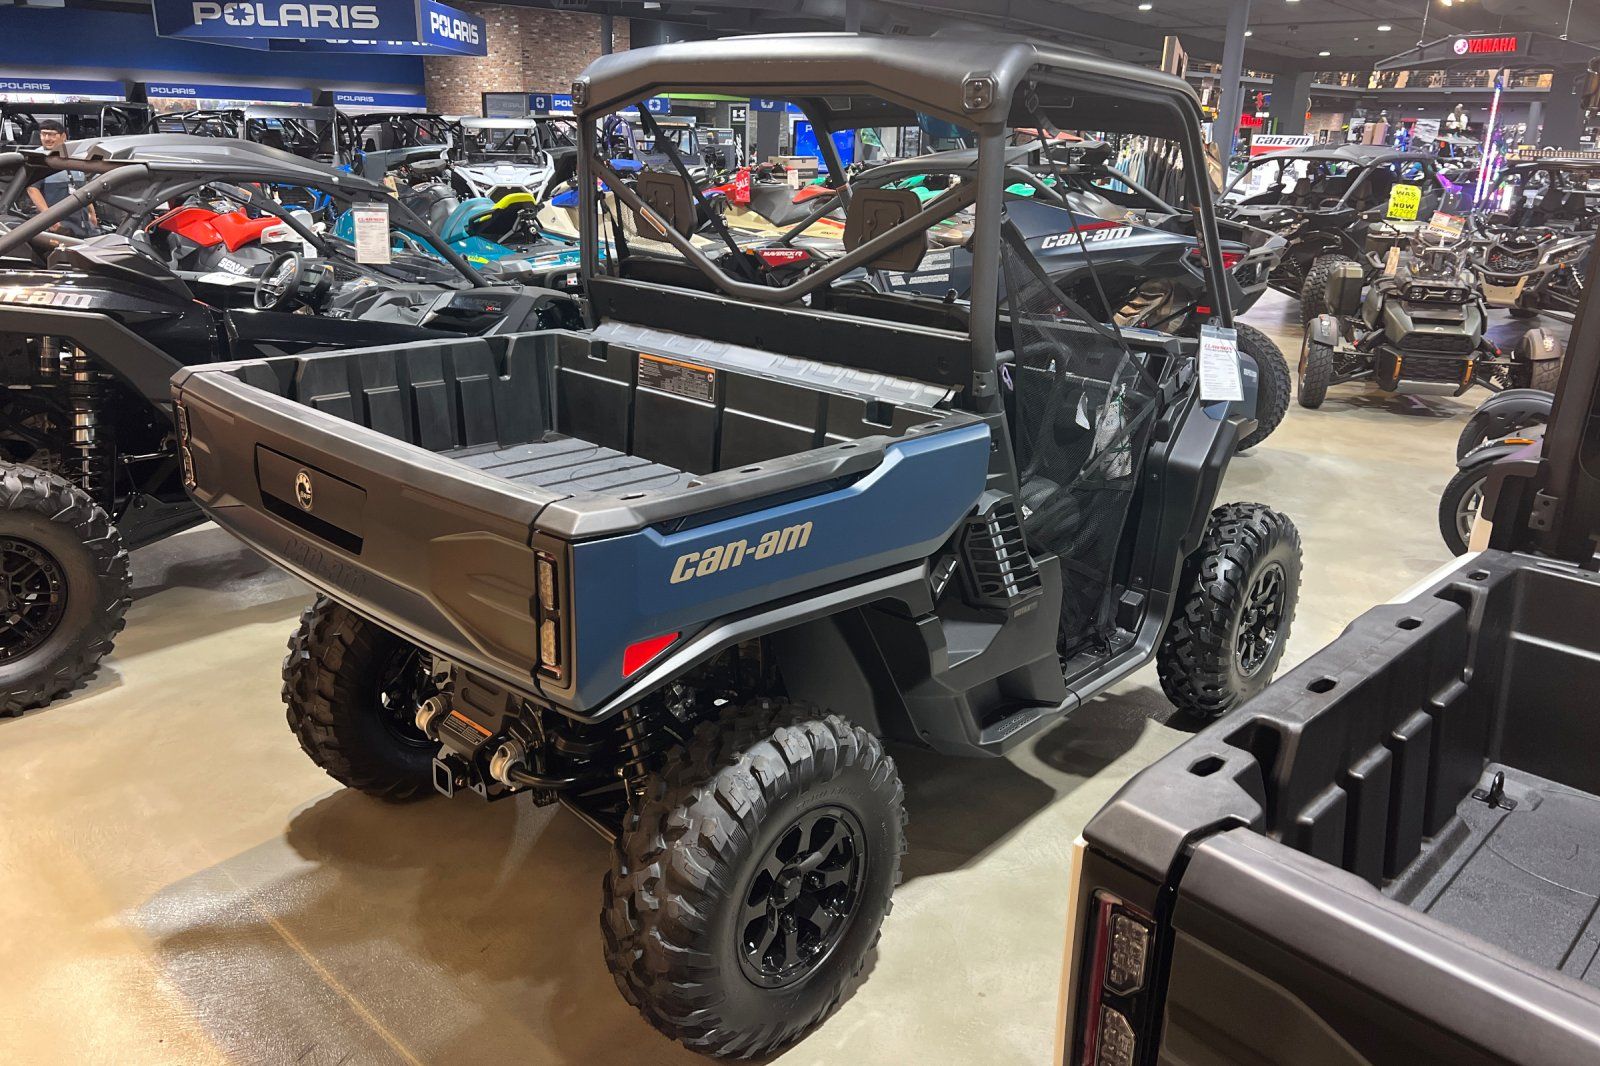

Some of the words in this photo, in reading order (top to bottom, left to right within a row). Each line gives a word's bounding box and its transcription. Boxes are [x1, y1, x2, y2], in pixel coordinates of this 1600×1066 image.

[191, 2, 380, 30] POLARIS
[429, 11, 479, 45] POLARIS
[1468, 37, 1517, 53] YAMAHA
[0, 82, 51, 90] POLARIS
[150, 86, 196, 95] POLARIS
[337, 95, 375, 103] POLARIS
[1255, 136, 1310, 145] can-am
[736, 177, 749, 191] SALE
[1396, 190, 1416, 198] WAS
[1041, 226, 1133, 249] can-am
[669, 521, 813, 584] can-am
